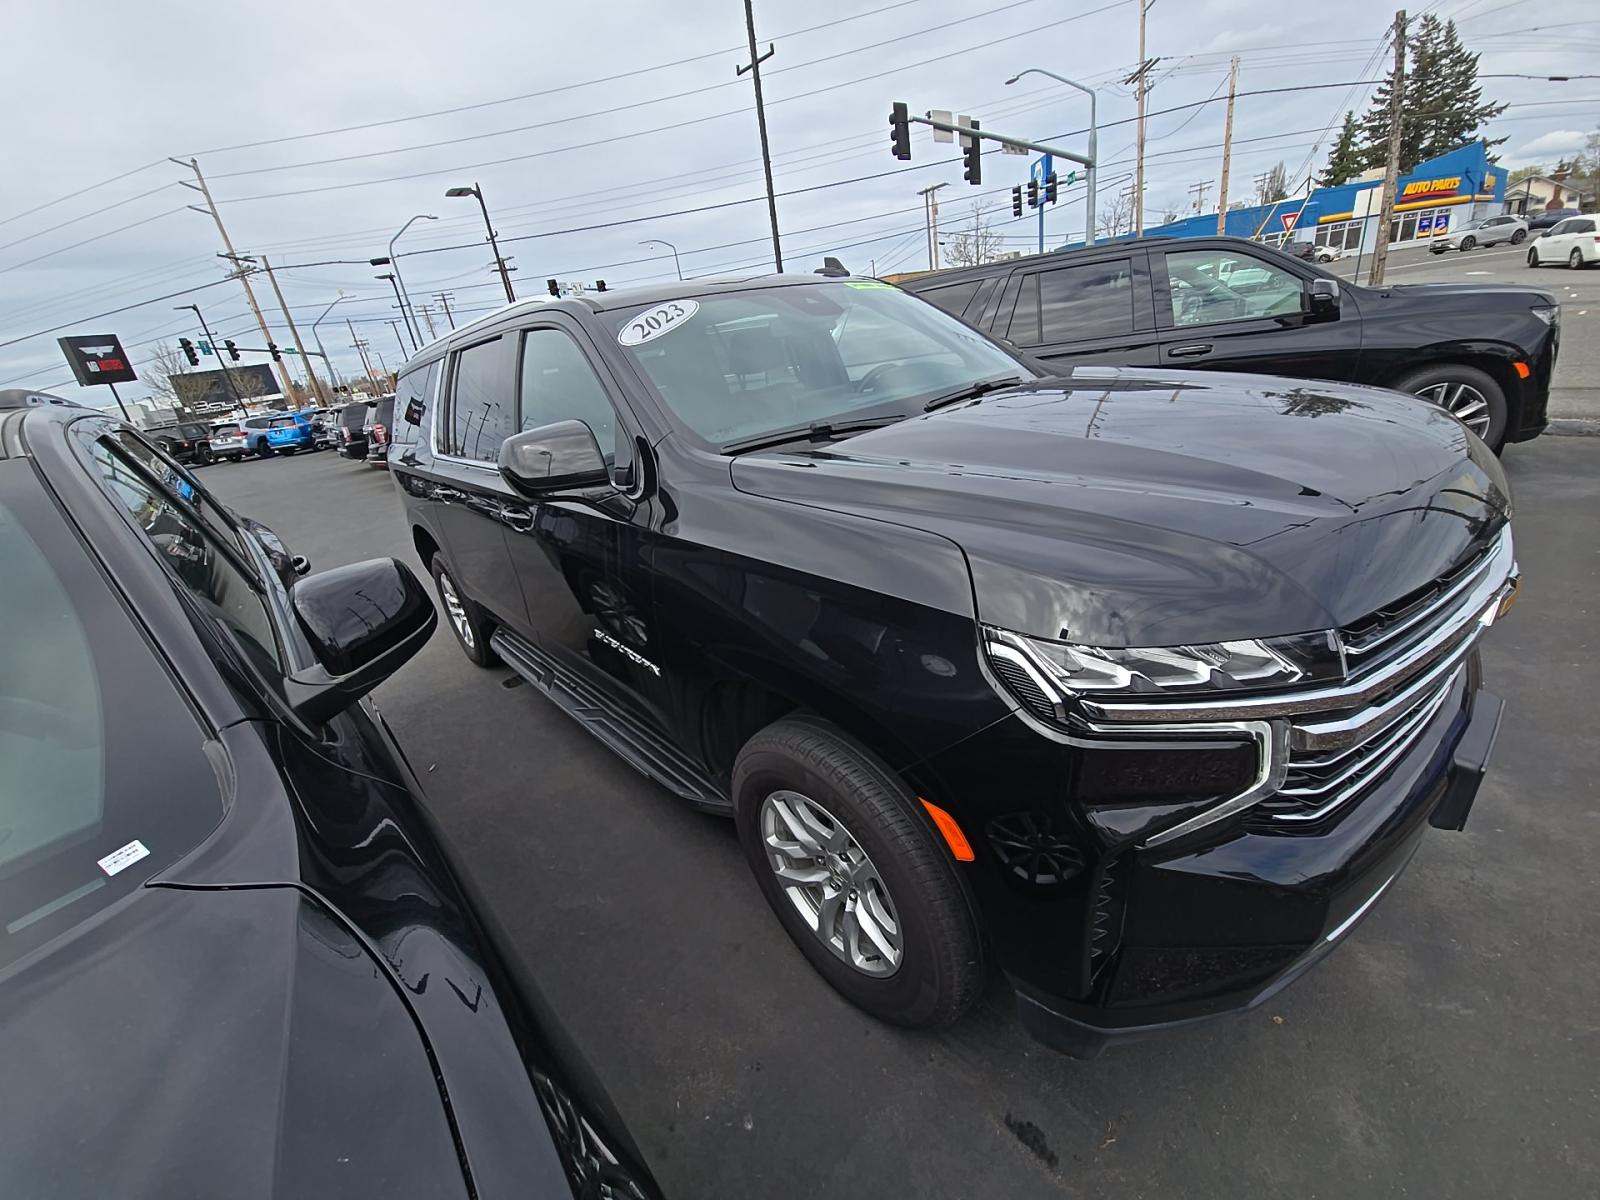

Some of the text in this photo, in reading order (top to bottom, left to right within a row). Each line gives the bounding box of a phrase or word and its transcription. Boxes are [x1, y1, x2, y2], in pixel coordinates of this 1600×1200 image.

[1403, 177, 1461, 195] AUTO PARTS
[632, 304, 685, 339] 2023
